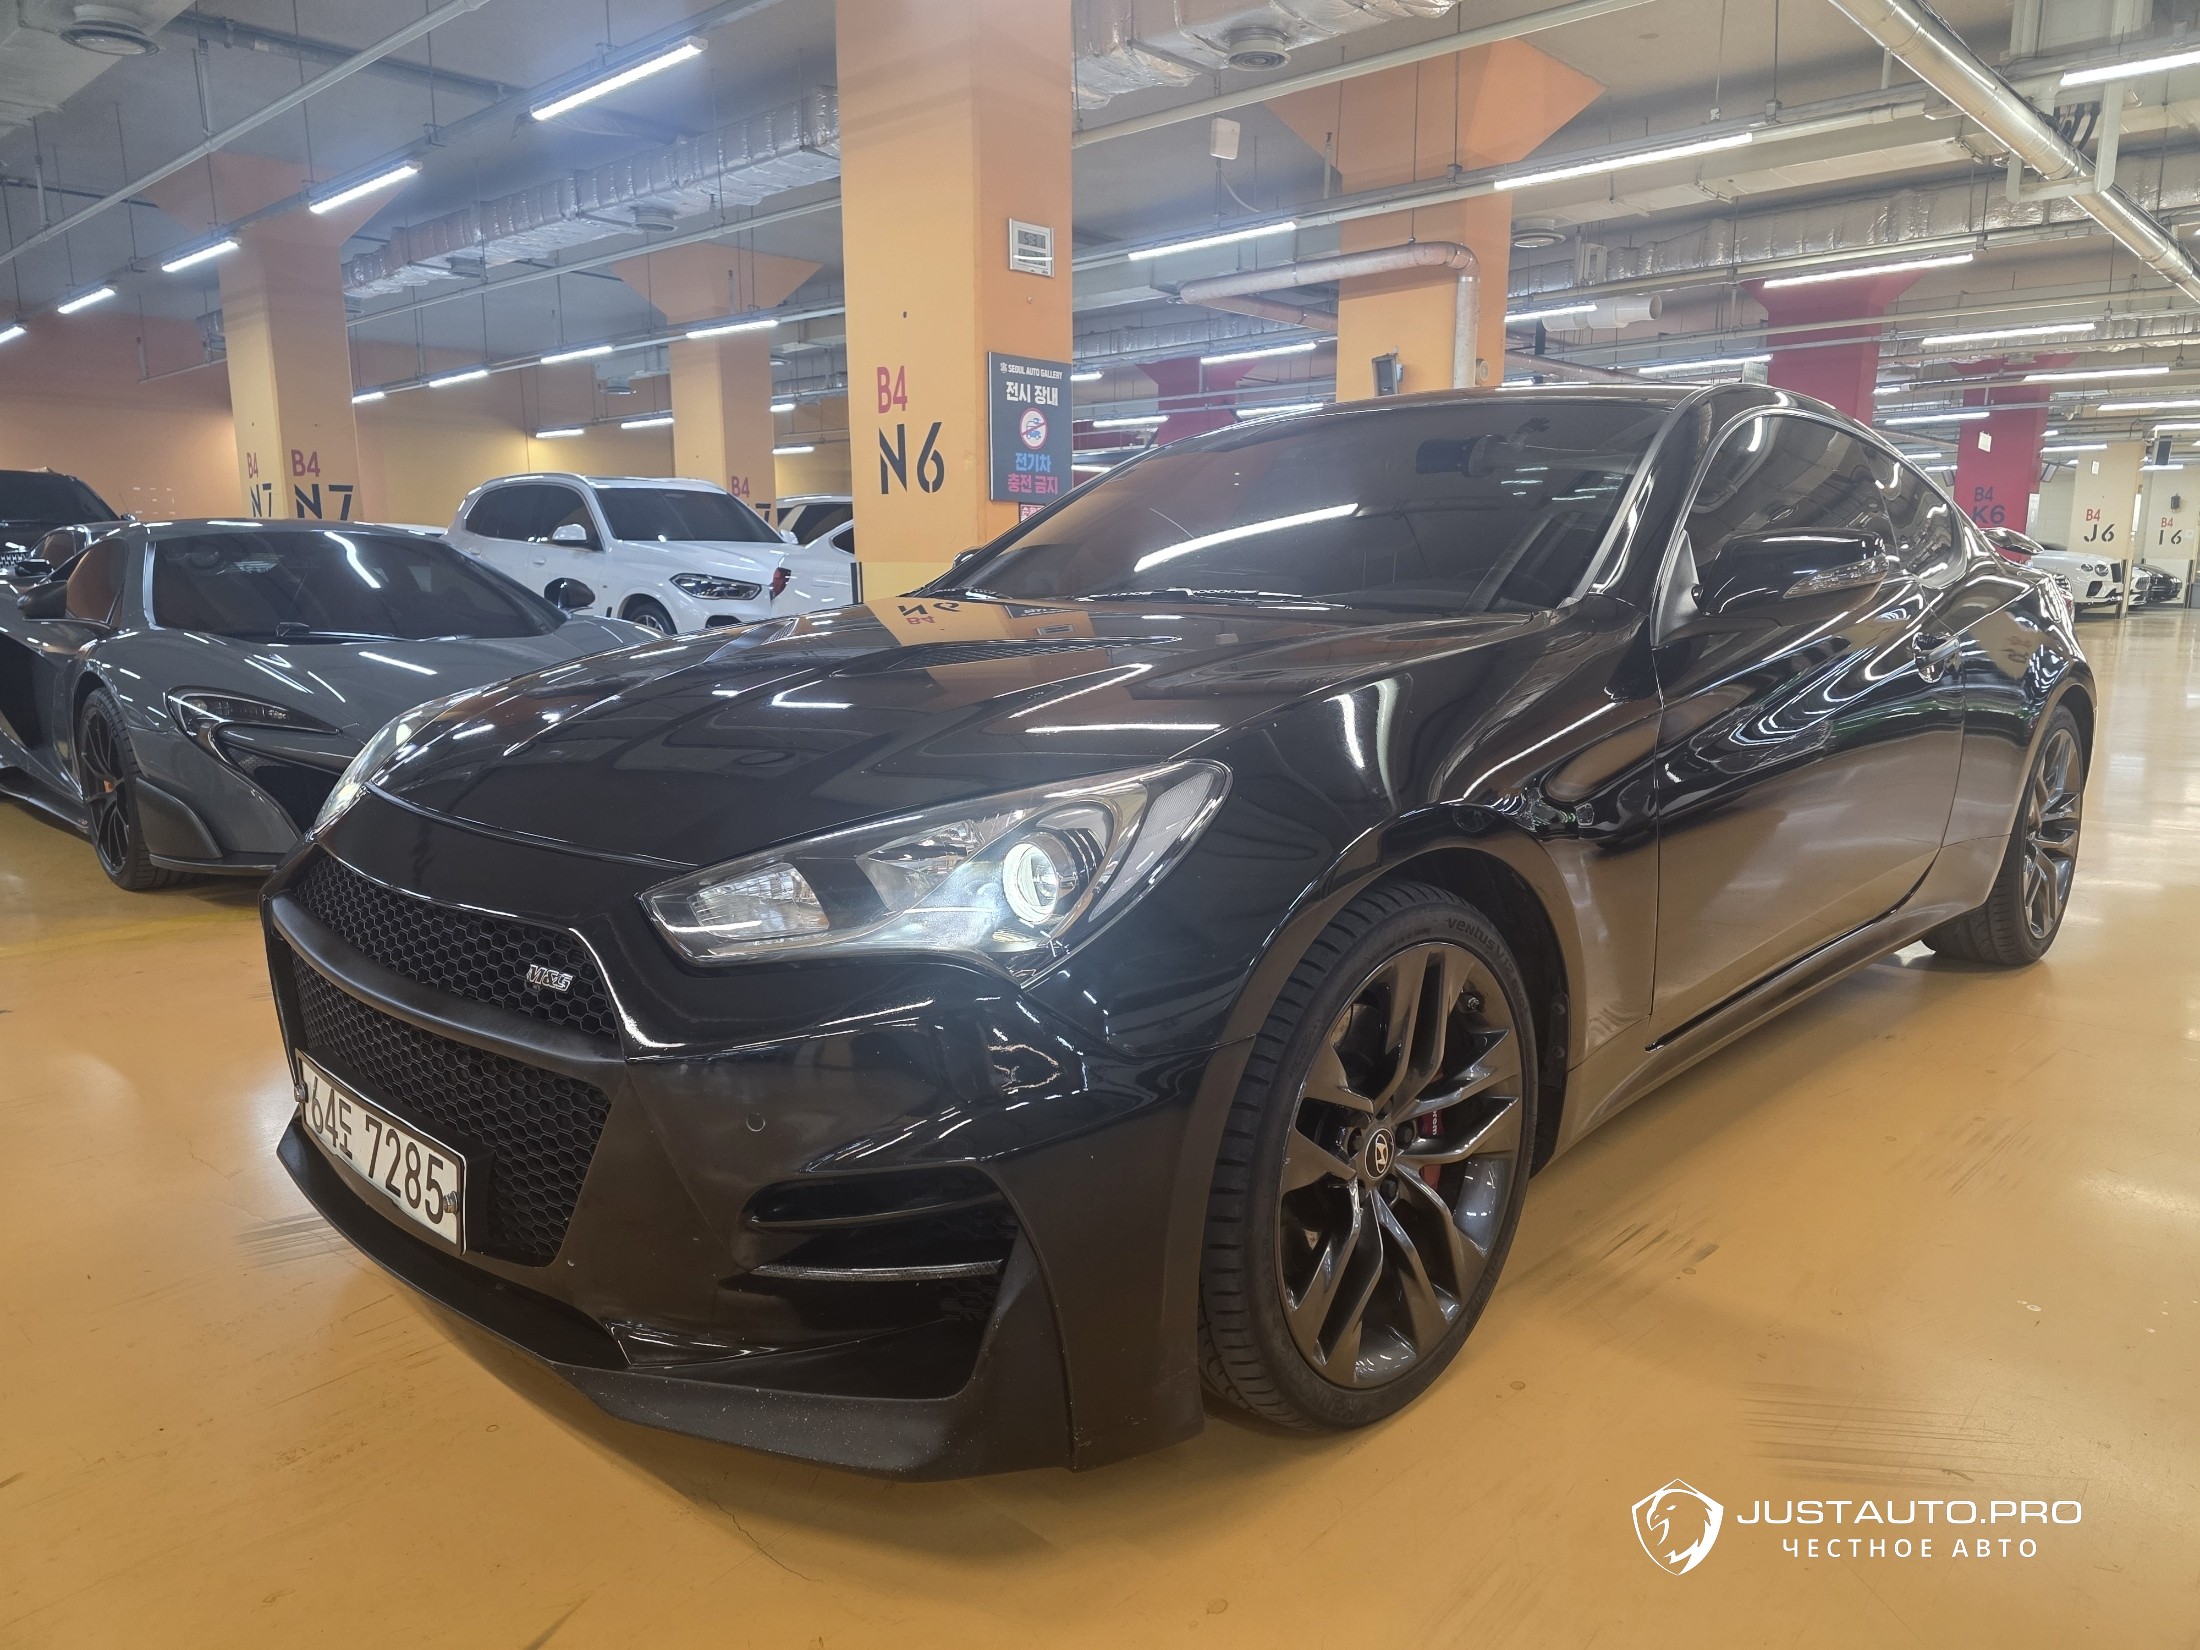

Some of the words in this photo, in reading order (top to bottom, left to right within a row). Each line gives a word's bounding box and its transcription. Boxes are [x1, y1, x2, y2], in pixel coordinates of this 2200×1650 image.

[1008, 364, 1026, 375] SEOUL
[1026, 366, 1040, 377] AUTO
[1040, 369, 1063, 380] GALLERY
[877, 365, 908, 413] B4
[1006, 381, 1031, 403] 전시
[1034, 385, 1059, 406] 장내
[246, 452, 259, 479] B4
[290, 449, 321, 477] B4
[879, 421, 945, 494] N6
[1015, 452, 1052, 473] 전기차
[731, 476, 750, 498] B4
[1007, 473, 1032, 493] 충전
[1035, 475, 1059, 495] 금지
[1974, 486, 1994, 502] B4
[294, 484, 354, 520] N7
[1972, 504, 2005, 525] K6
[2086, 508, 2101, 521] B4
[2161, 517, 2174, 528] B4
[2083, 524, 2115, 542] J6
[365, 1113, 444, 1225] 7285
